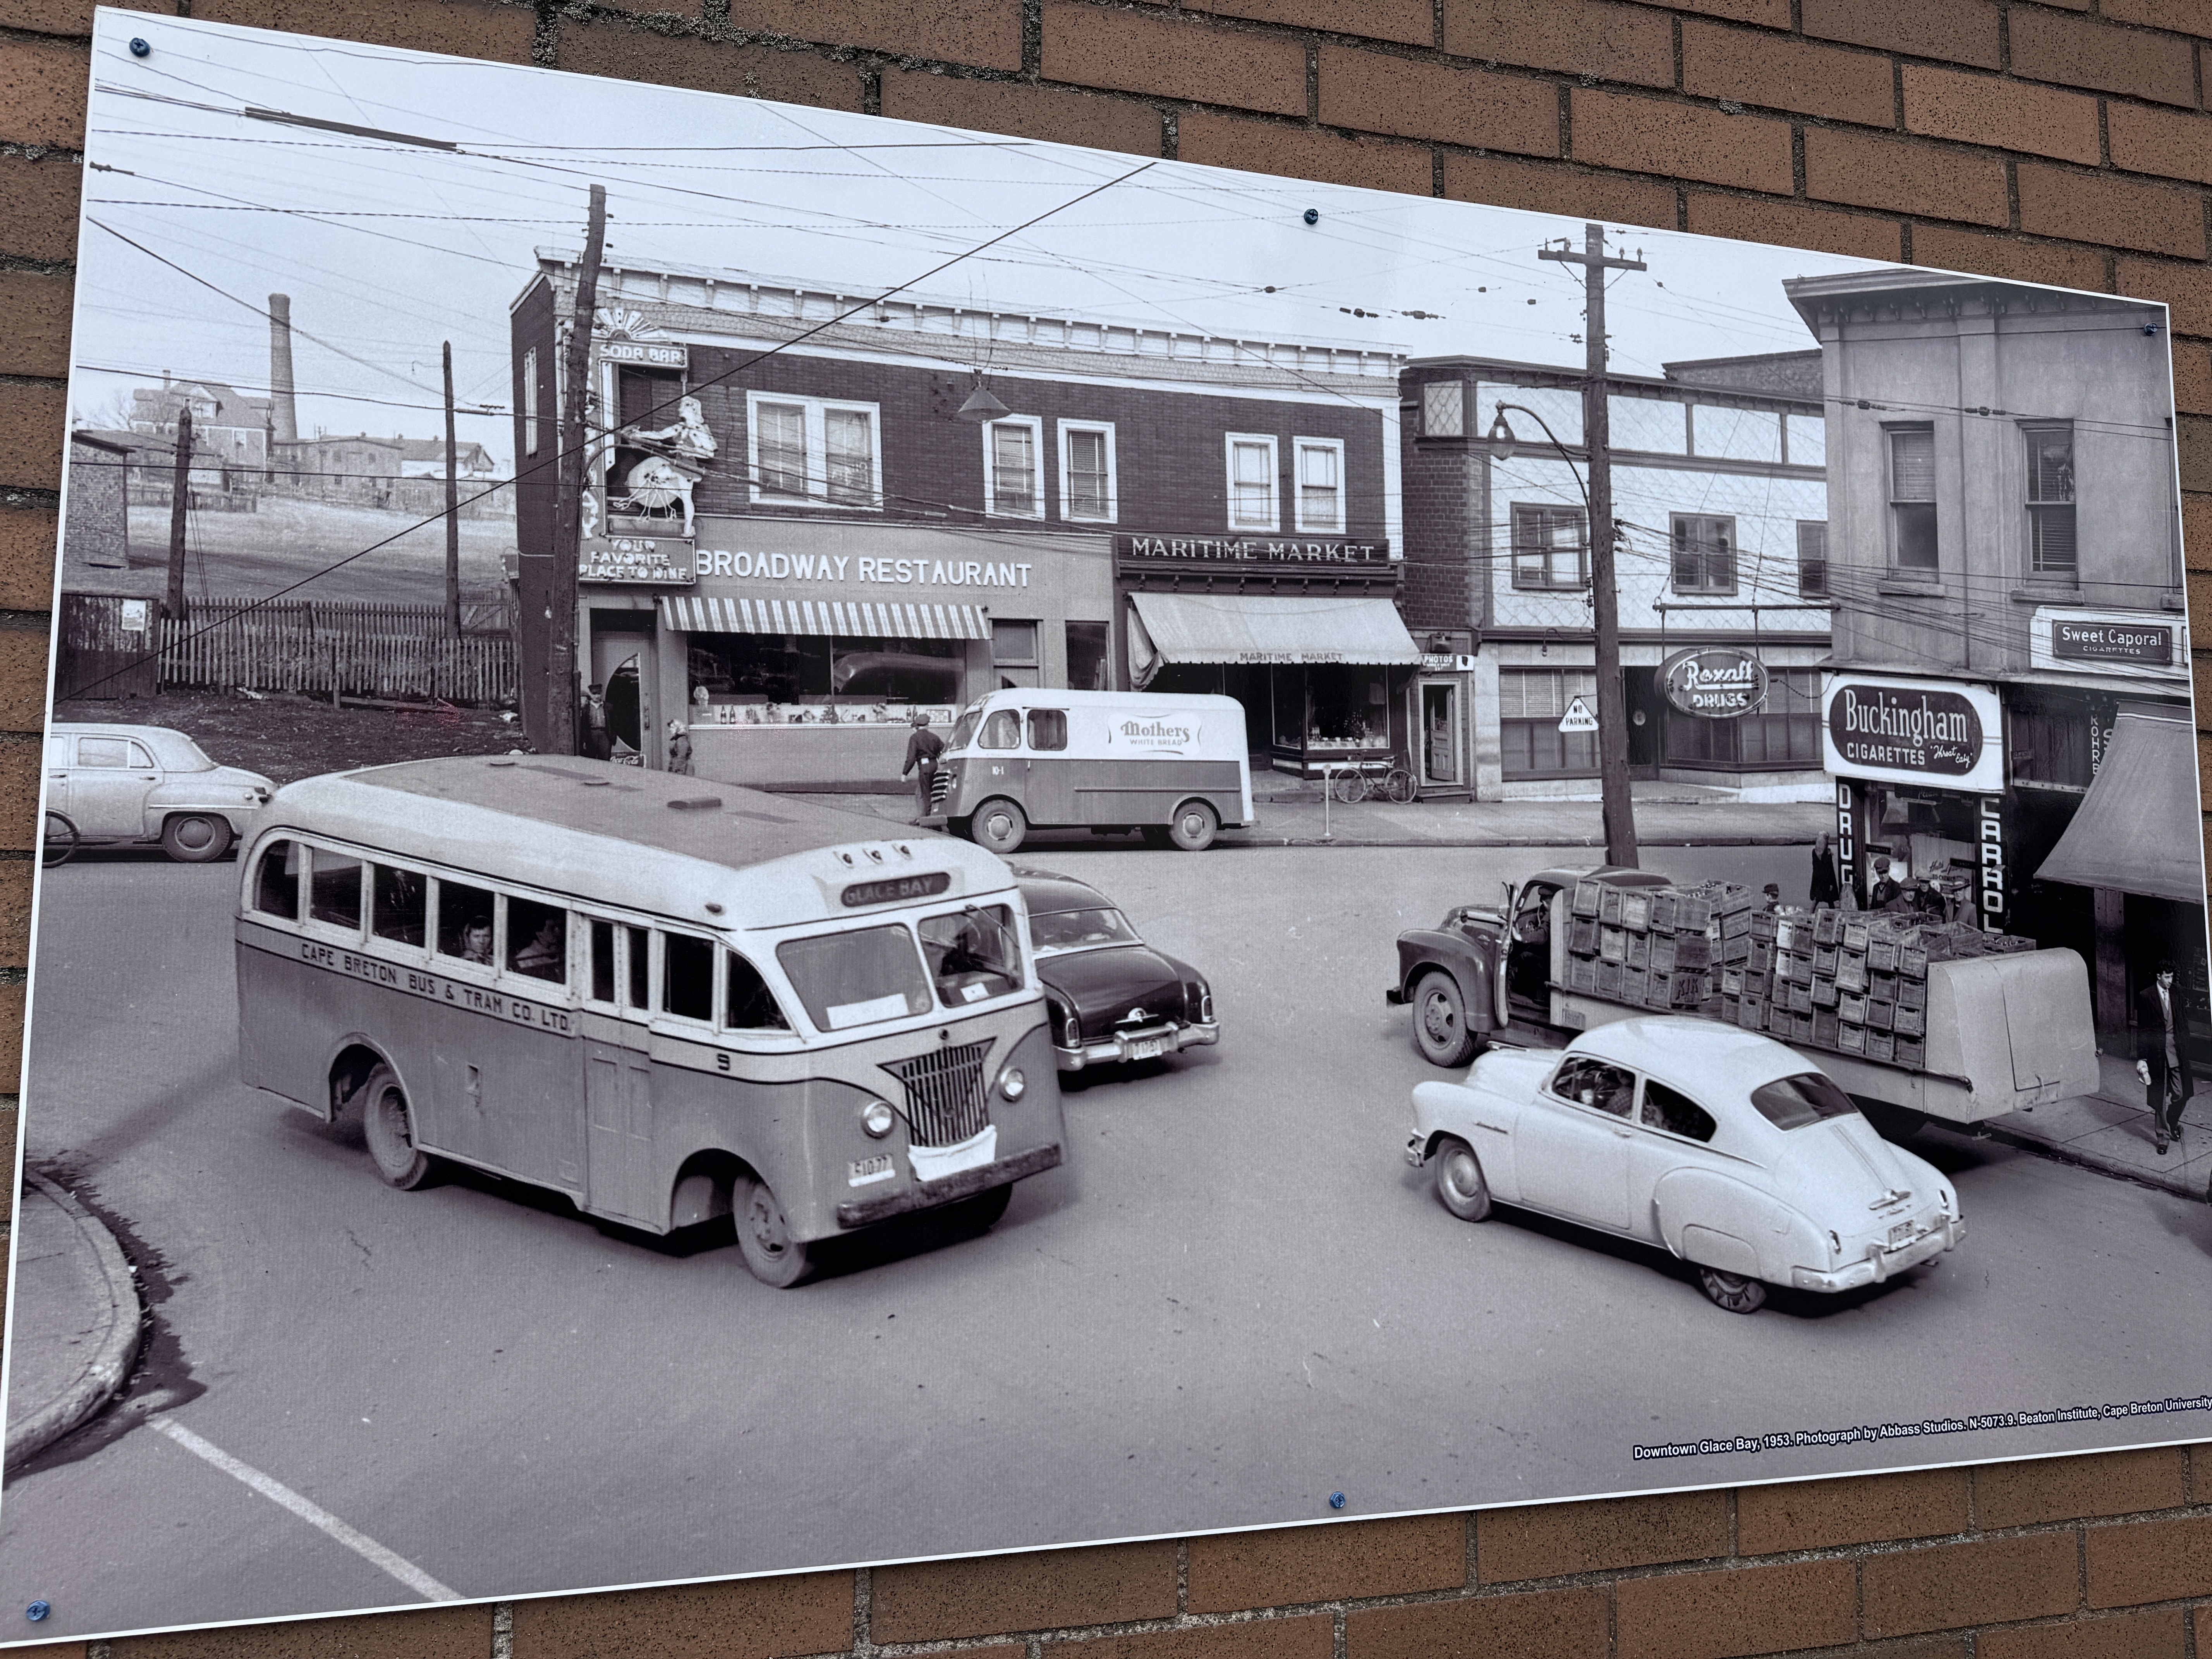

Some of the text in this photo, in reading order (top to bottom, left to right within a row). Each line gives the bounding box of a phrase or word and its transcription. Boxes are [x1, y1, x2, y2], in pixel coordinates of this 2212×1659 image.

[600, 344, 682, 363] SODA BAR
[612, 539, 655, 552] YOUR
[1132, 537, 1374, 563] MARITIME MARKET
[591, 551, 670, 566] FAVORITE
[696, 549, 1032, 587] BROADWAY RESTAURANT
[579, 564, 687, 580] PLACE TO DINE
[2062, 626, 2162, 647] Sweet Caporal
[1240, 652, 1344, 662] MARITIME MARKET
[2083, 646, 2141, 655] CIGARETTES
[1682, 660, 1754, 691] Rexall
[1573, 705, 1582, 714] NO
[1692, 692, 1747, 707] DRUGS
[1566, 717, 1593, 726] PARKING
[1844, 689, 1967, 747] Buckingham
[1120, 720, 1190, 743] Mothers
[1847, 742, 1925, 766] CIGARETTES
[1980, 796, 2004, 935] CARROL
[845, 876, 933, 904] GLACE BAY
[302, 943, 334, 966] CAPE
[344, 955, 397, 984] BRETON
[409, 973, 435, 994] BUS
[445, 984, 455, 1000] &
[464, 989, 503, 1014] TRAM
[1635, 1397, 2212, 1458] Downtown Glace Bay, 1953. Photograph by Abbass Studios. N-5073.9. Beaton Institute, Cape Breton University
